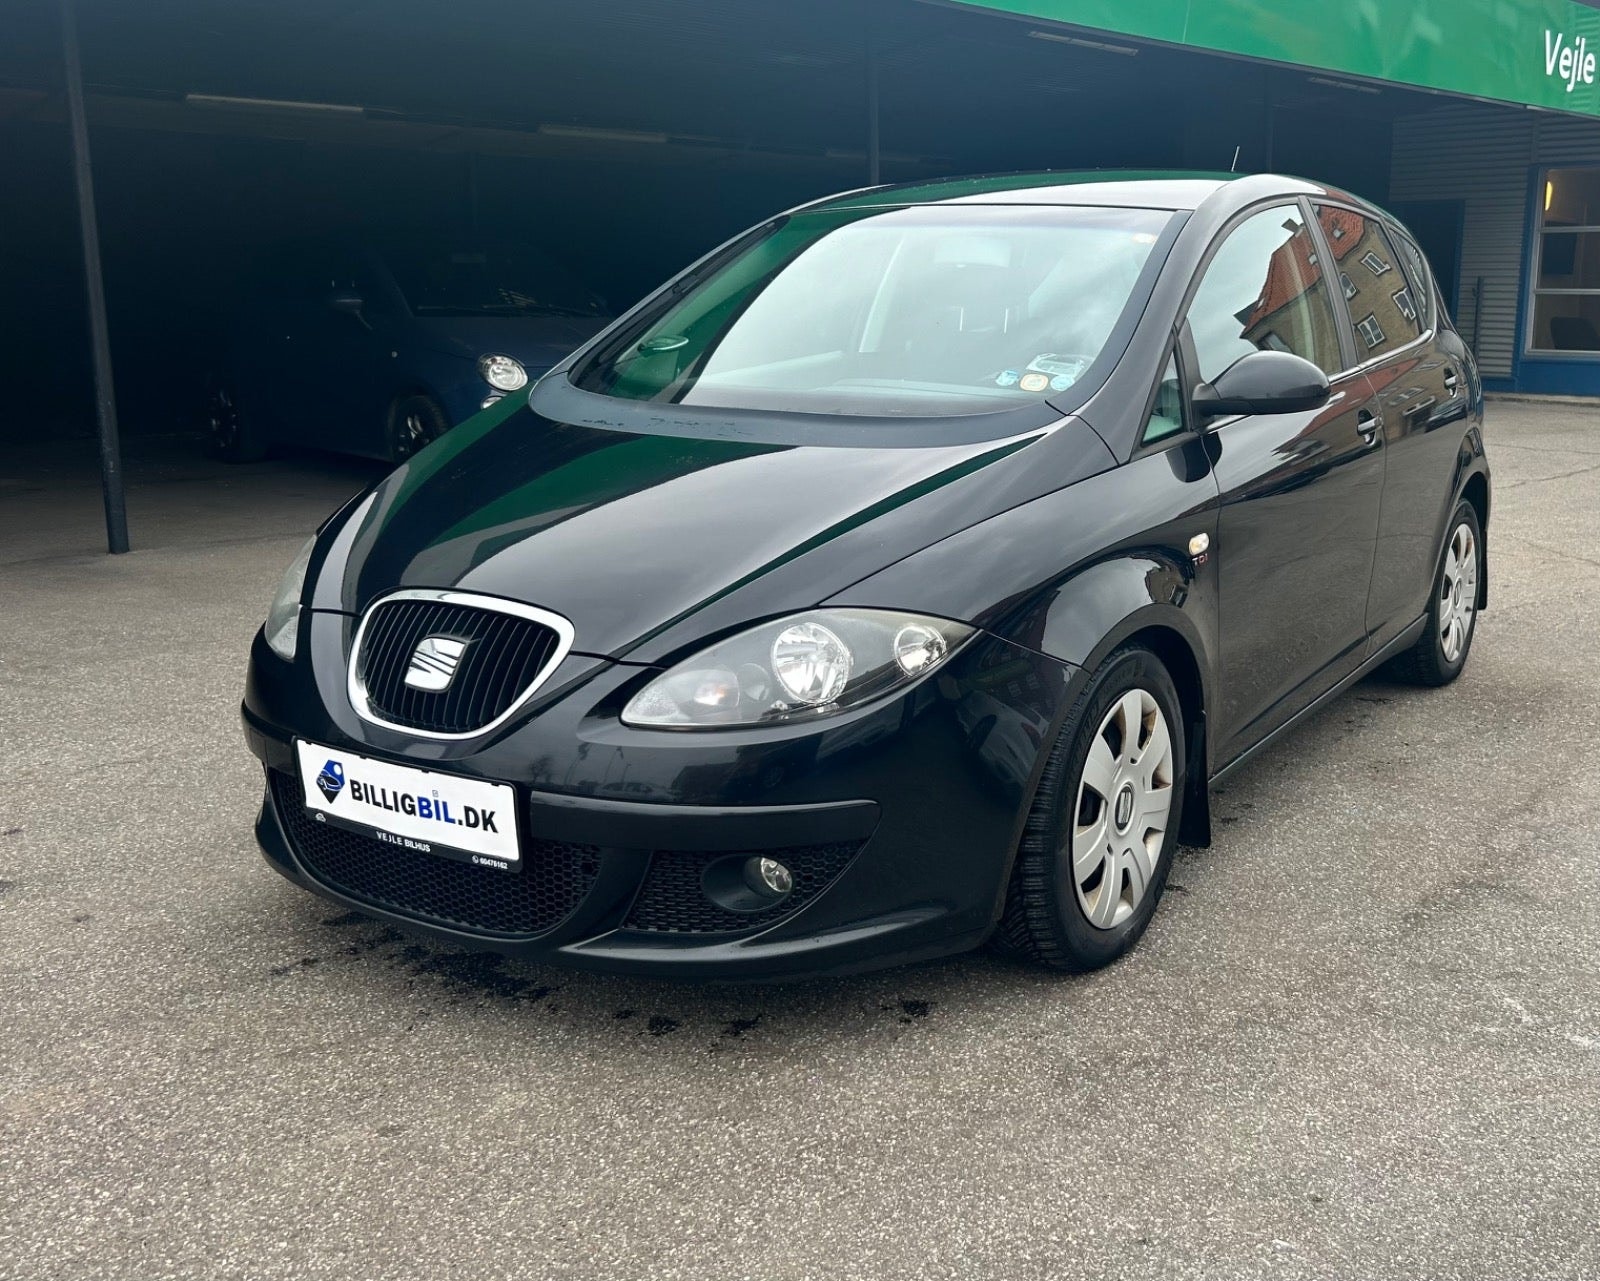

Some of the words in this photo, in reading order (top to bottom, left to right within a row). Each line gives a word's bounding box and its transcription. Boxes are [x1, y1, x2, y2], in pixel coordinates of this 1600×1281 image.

[1544, 29, 1596, 93] Vejle
[350, 778, 499, 833] BILLIGBIL.DK
[376, 831, 403, 846] VEJLE
[404, 838, 431, 853] BILHUS
